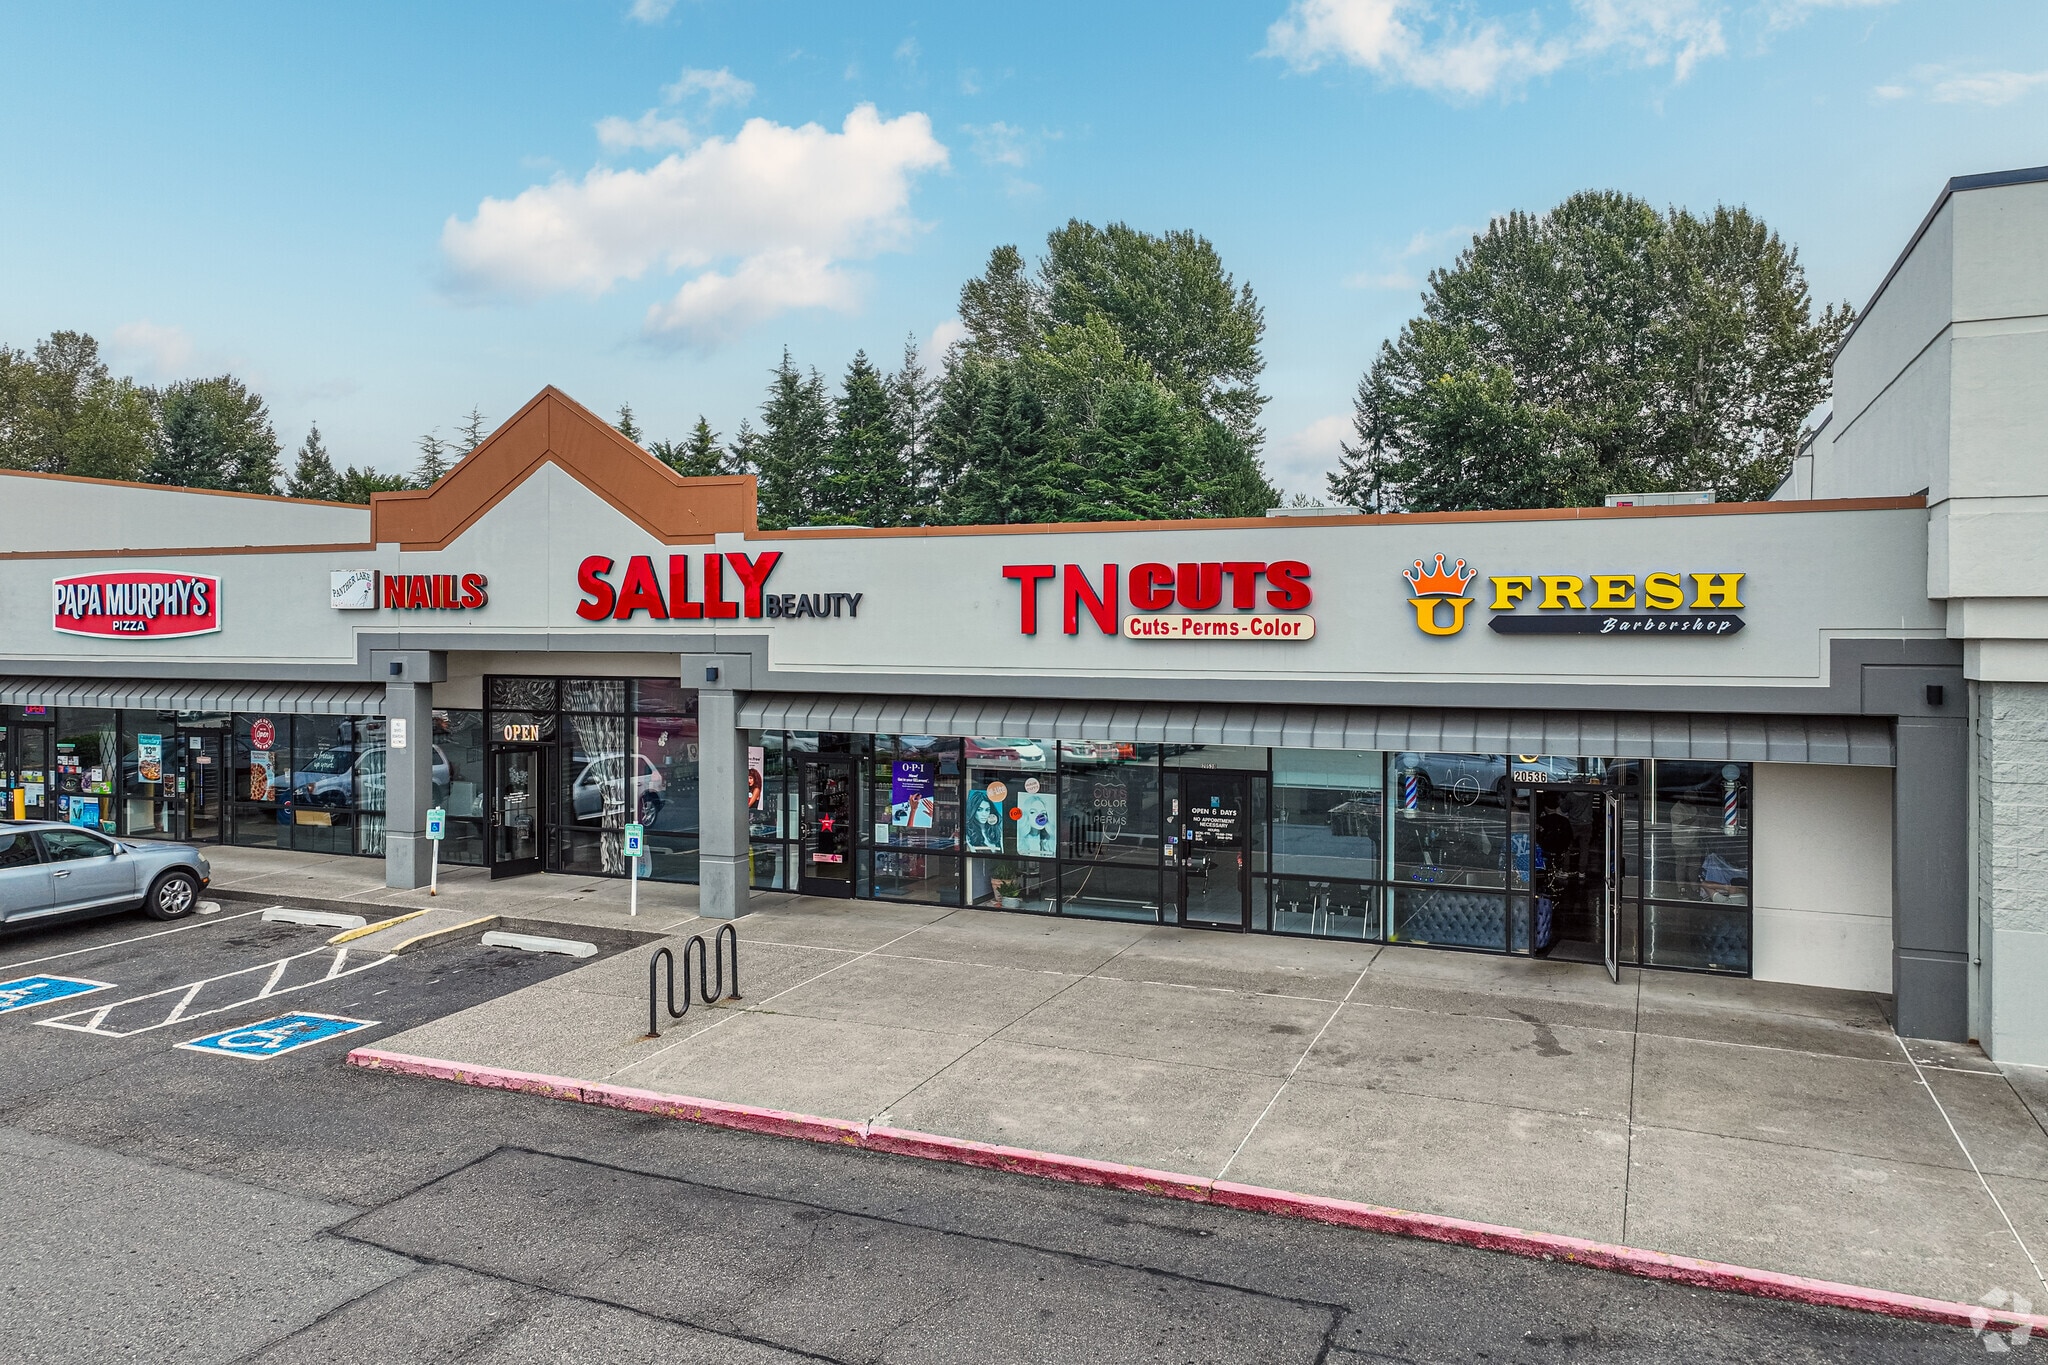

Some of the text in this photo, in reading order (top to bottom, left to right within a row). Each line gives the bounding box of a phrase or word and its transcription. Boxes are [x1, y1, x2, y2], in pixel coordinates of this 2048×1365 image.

[332, 576, 356, 598] PANTHER
[384, 573, 487, 609] NAILS
[576, 551, 863, 621] SALLY BEAUTY
[1488, 572, 1746, 610] FRESH
[55, 578, 209, 620] PAPA MURPHY'S
[1002, 560, 1312, 635] TN CUTS
[112, 621, 147, 631] PIZZA
[1407, 597, 1475, 636] U
[1600, 617, 1732, 635] Barbershop
[503, 724, 540, 741] OPEN
[1514, 772, 1547, 782] 20536
[1093, 799, 1127, 807] COLOR
[1093, 816, 1127, 826] PERMS
